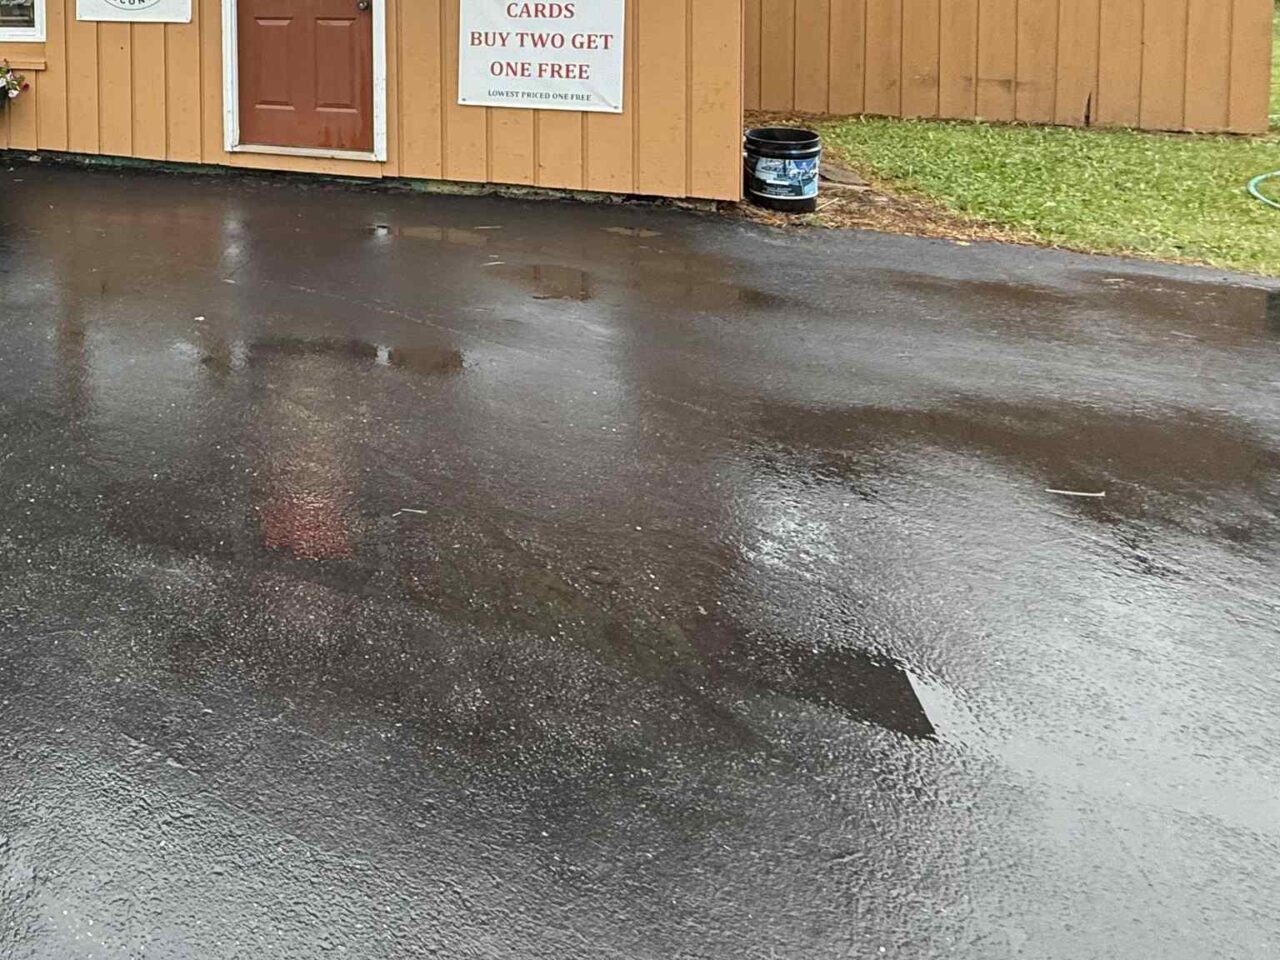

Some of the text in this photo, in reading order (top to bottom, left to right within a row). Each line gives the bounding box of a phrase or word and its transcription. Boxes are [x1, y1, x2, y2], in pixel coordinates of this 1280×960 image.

[506, 3, 576, 19] CARDS
[470, 31, 614, 50] BUY TWO GET
[490, 61, 590, 80] ONE FREE
[488, 90, 592, 102] LOWEST PRICED ONE FREE
